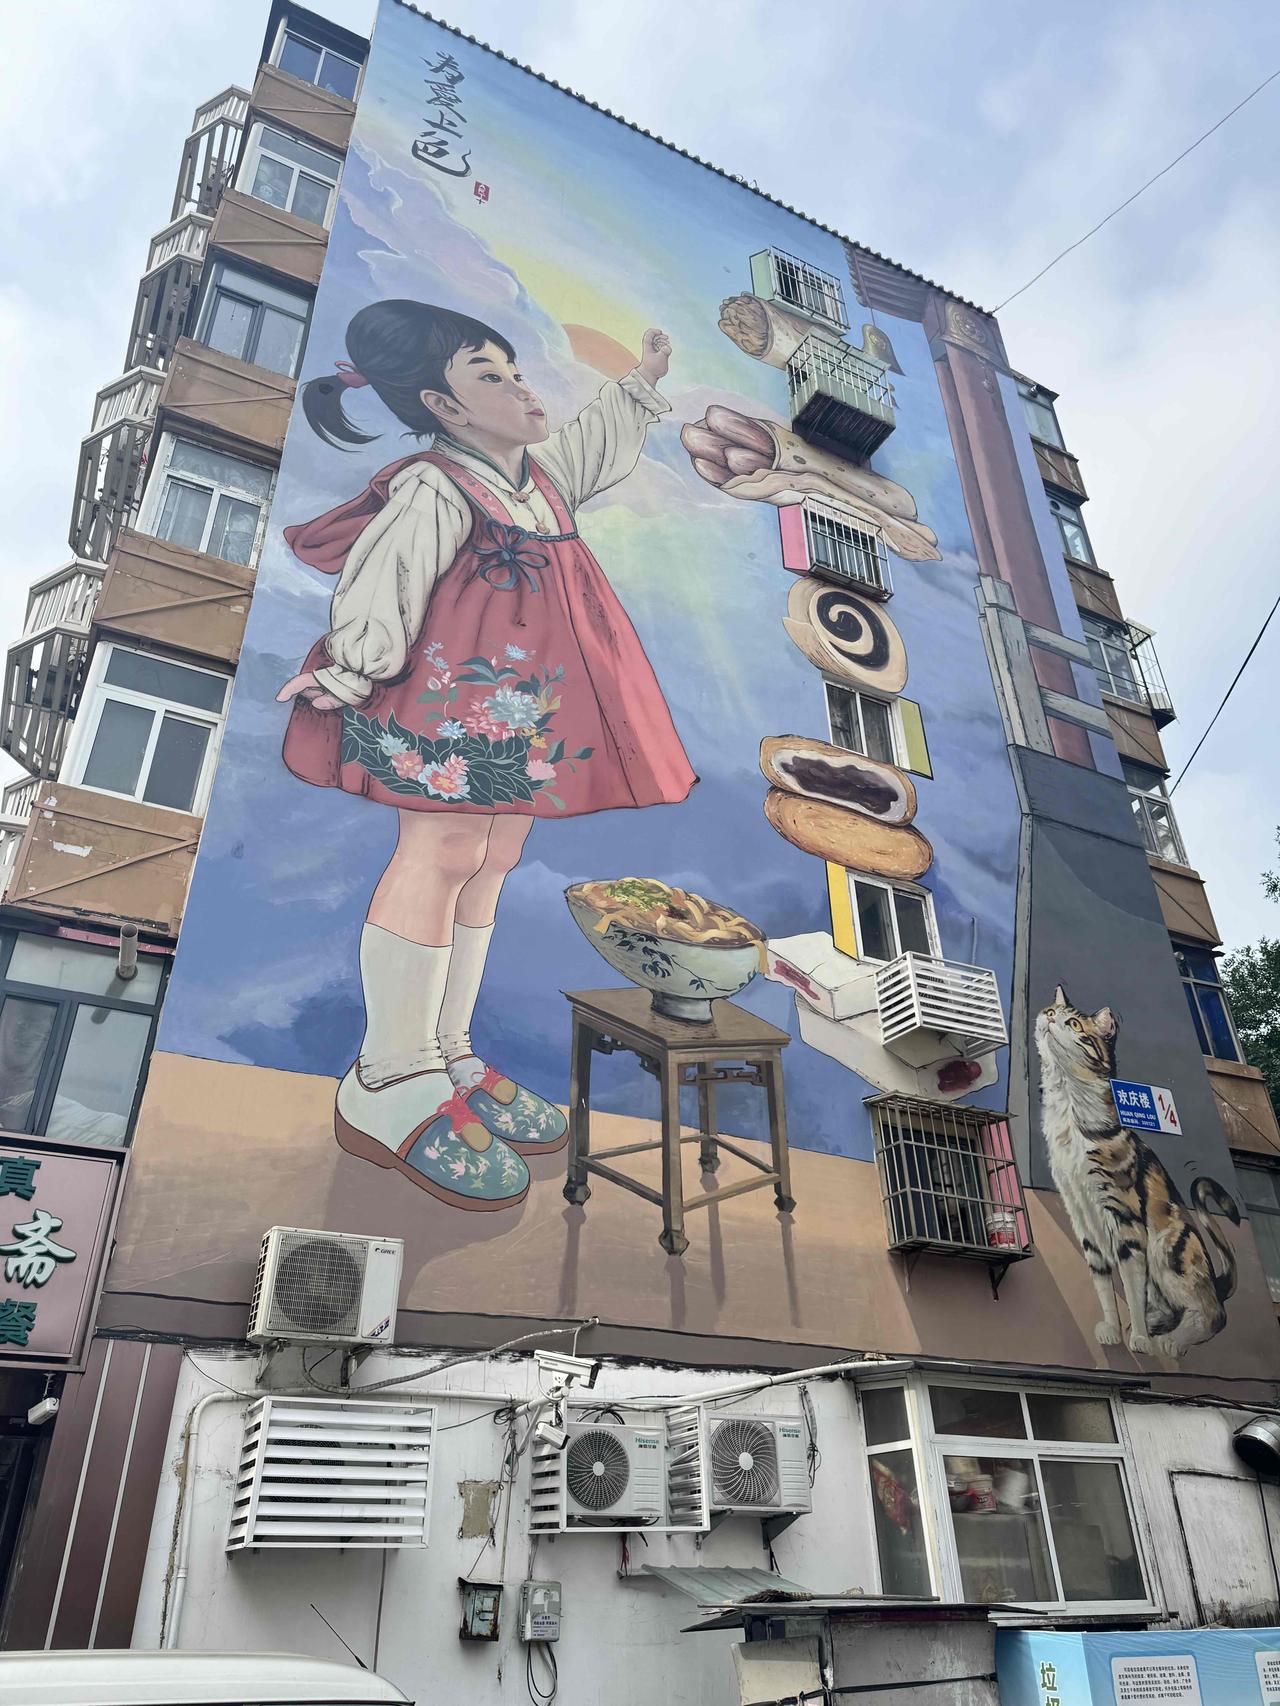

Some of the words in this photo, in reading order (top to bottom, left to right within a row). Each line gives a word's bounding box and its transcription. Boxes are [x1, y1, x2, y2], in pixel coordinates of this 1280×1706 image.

[1116, 1089, 1151, 1109] 欢庆楼
[1158, 1093, 1177, 1127] 1/4
[0, 1156, 42, 1201] 真
[0, 1208, 77, 1289] 斋
